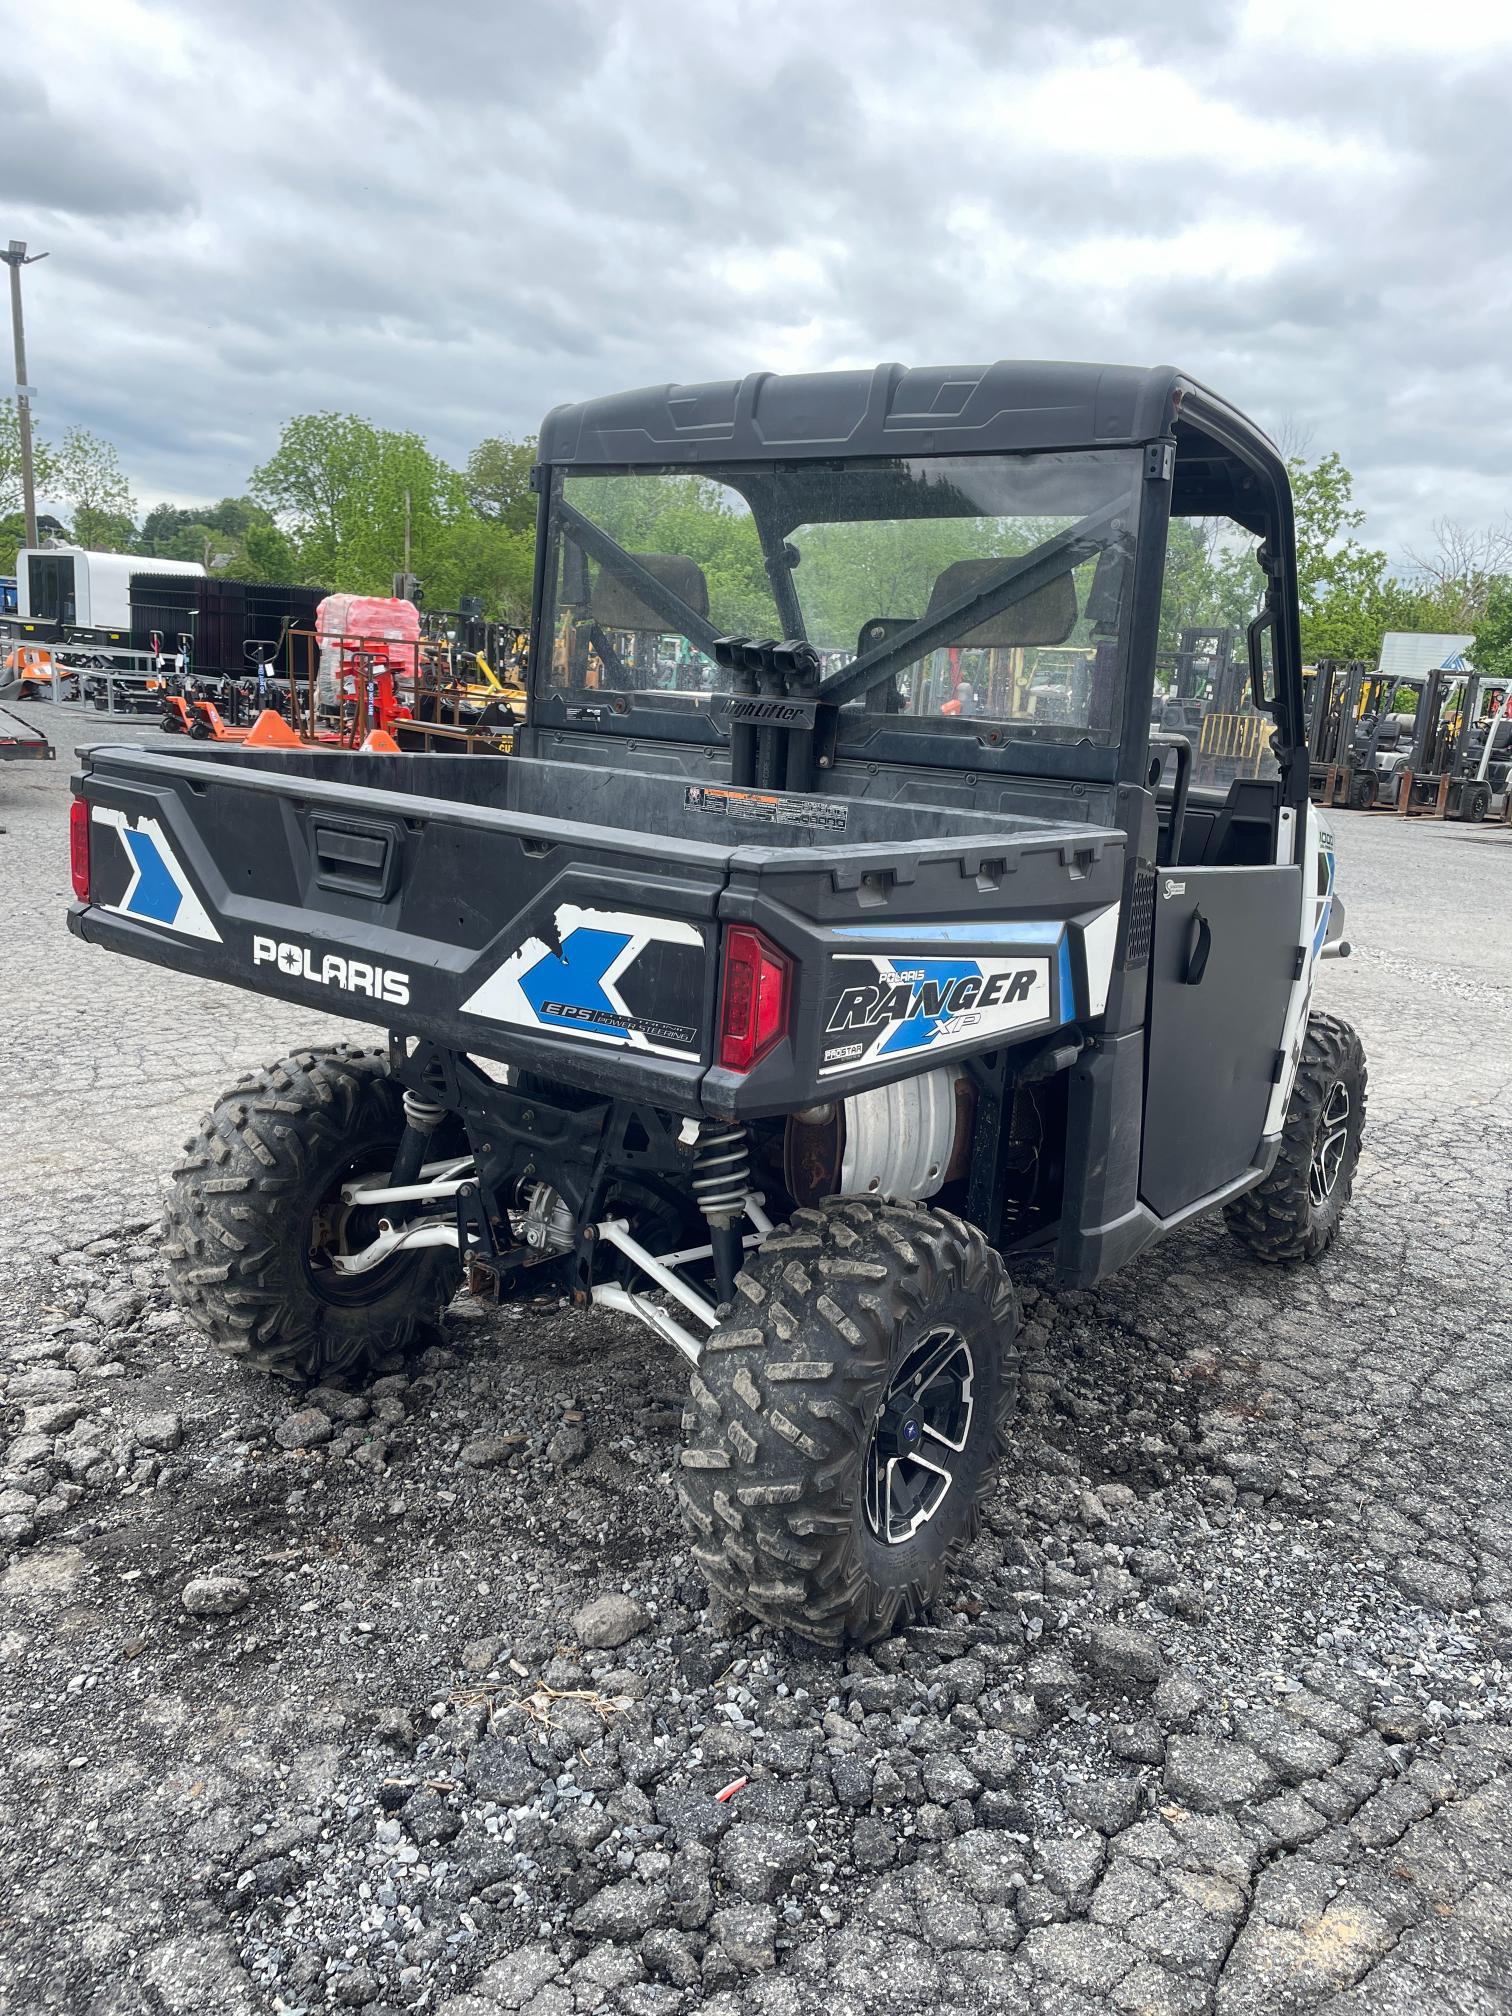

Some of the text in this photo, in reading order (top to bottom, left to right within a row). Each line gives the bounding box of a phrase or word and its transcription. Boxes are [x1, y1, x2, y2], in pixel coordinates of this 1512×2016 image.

[253, 934, 410, 1006] POLARIS
[878, 969, 925, 985] POLARIS
[545, 1002, 593, 1020] EPS
[825, 969, 1037, 1033] RANGER
[597, 1016, 636, 1030] POWER
[638, 1024, 690, 1041] STEERING
[923, 1012, 982, 1038] XP
